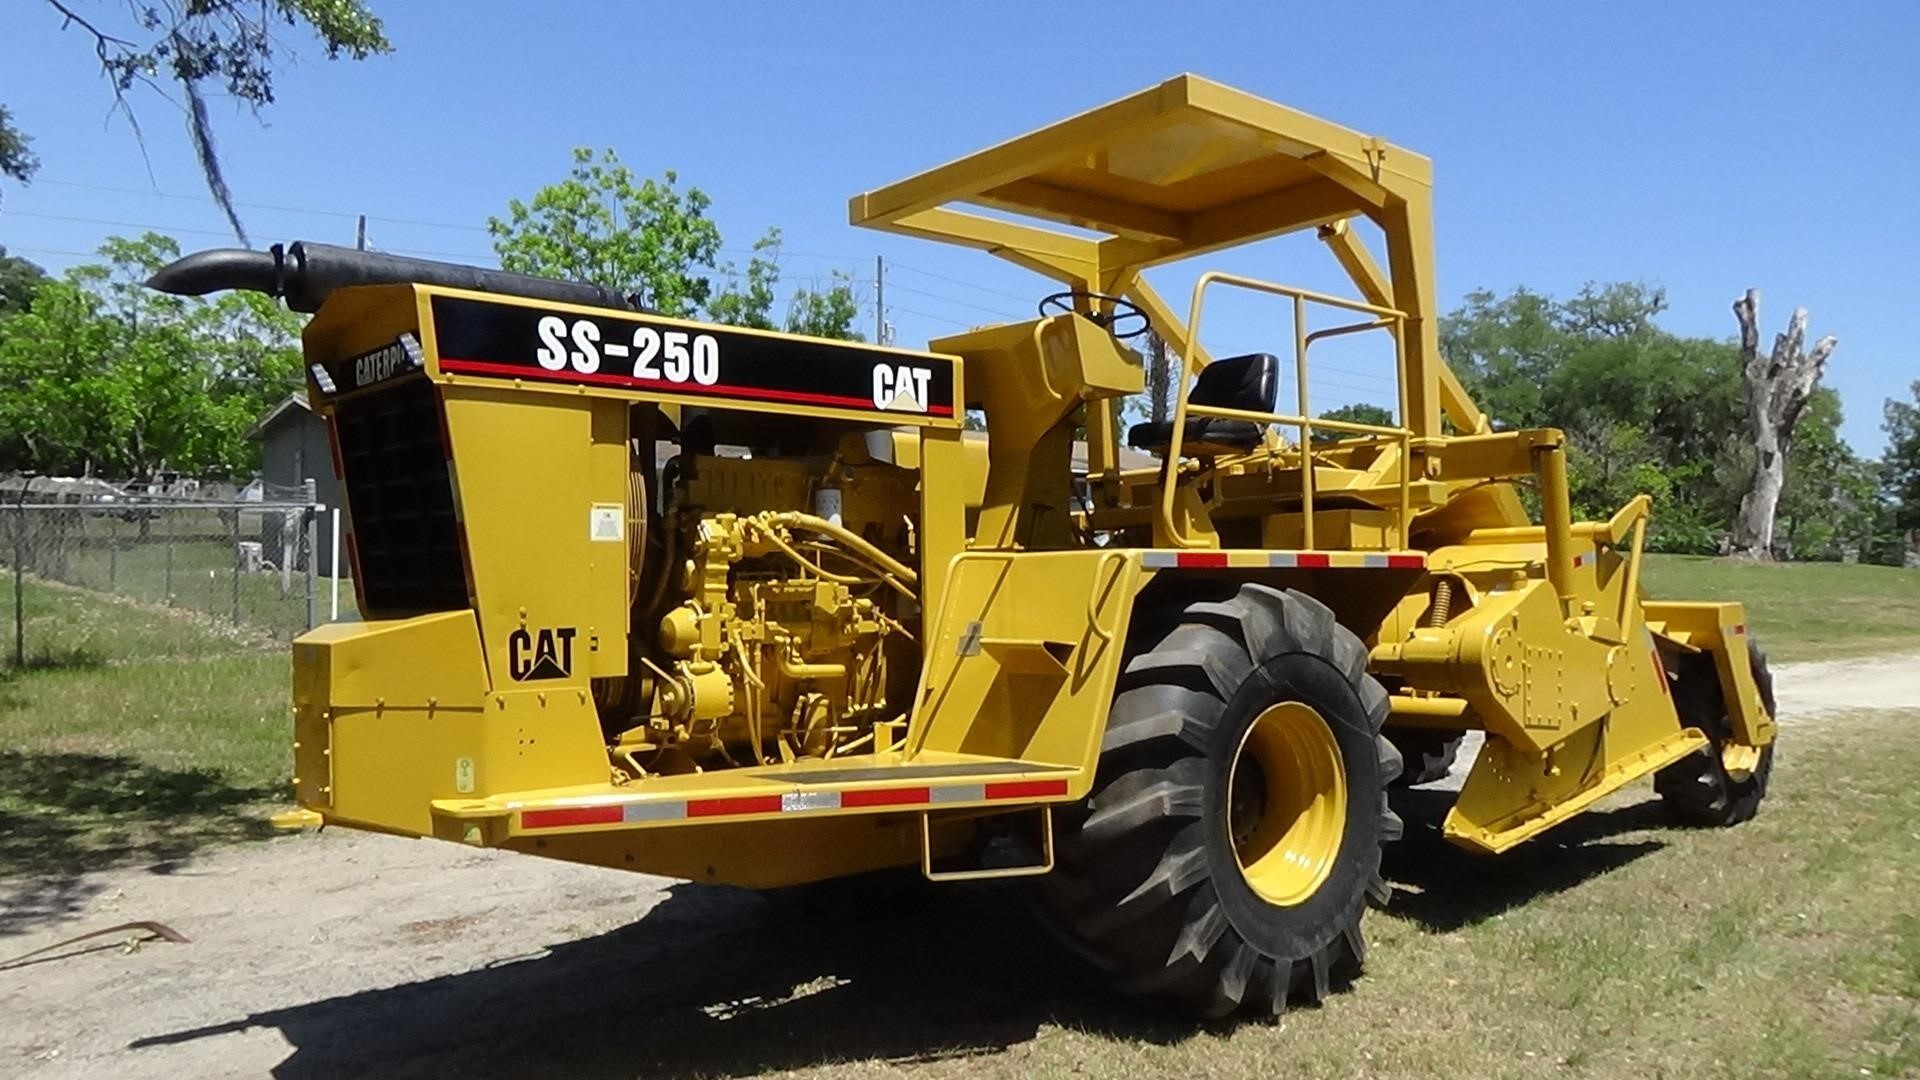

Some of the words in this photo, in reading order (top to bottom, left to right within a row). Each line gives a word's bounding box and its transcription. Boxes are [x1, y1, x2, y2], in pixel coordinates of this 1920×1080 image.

[537, 316, 719, 385] SS-250
[873, 363, 931, 413] CAT
[509, 627, 576, 682] CAT
